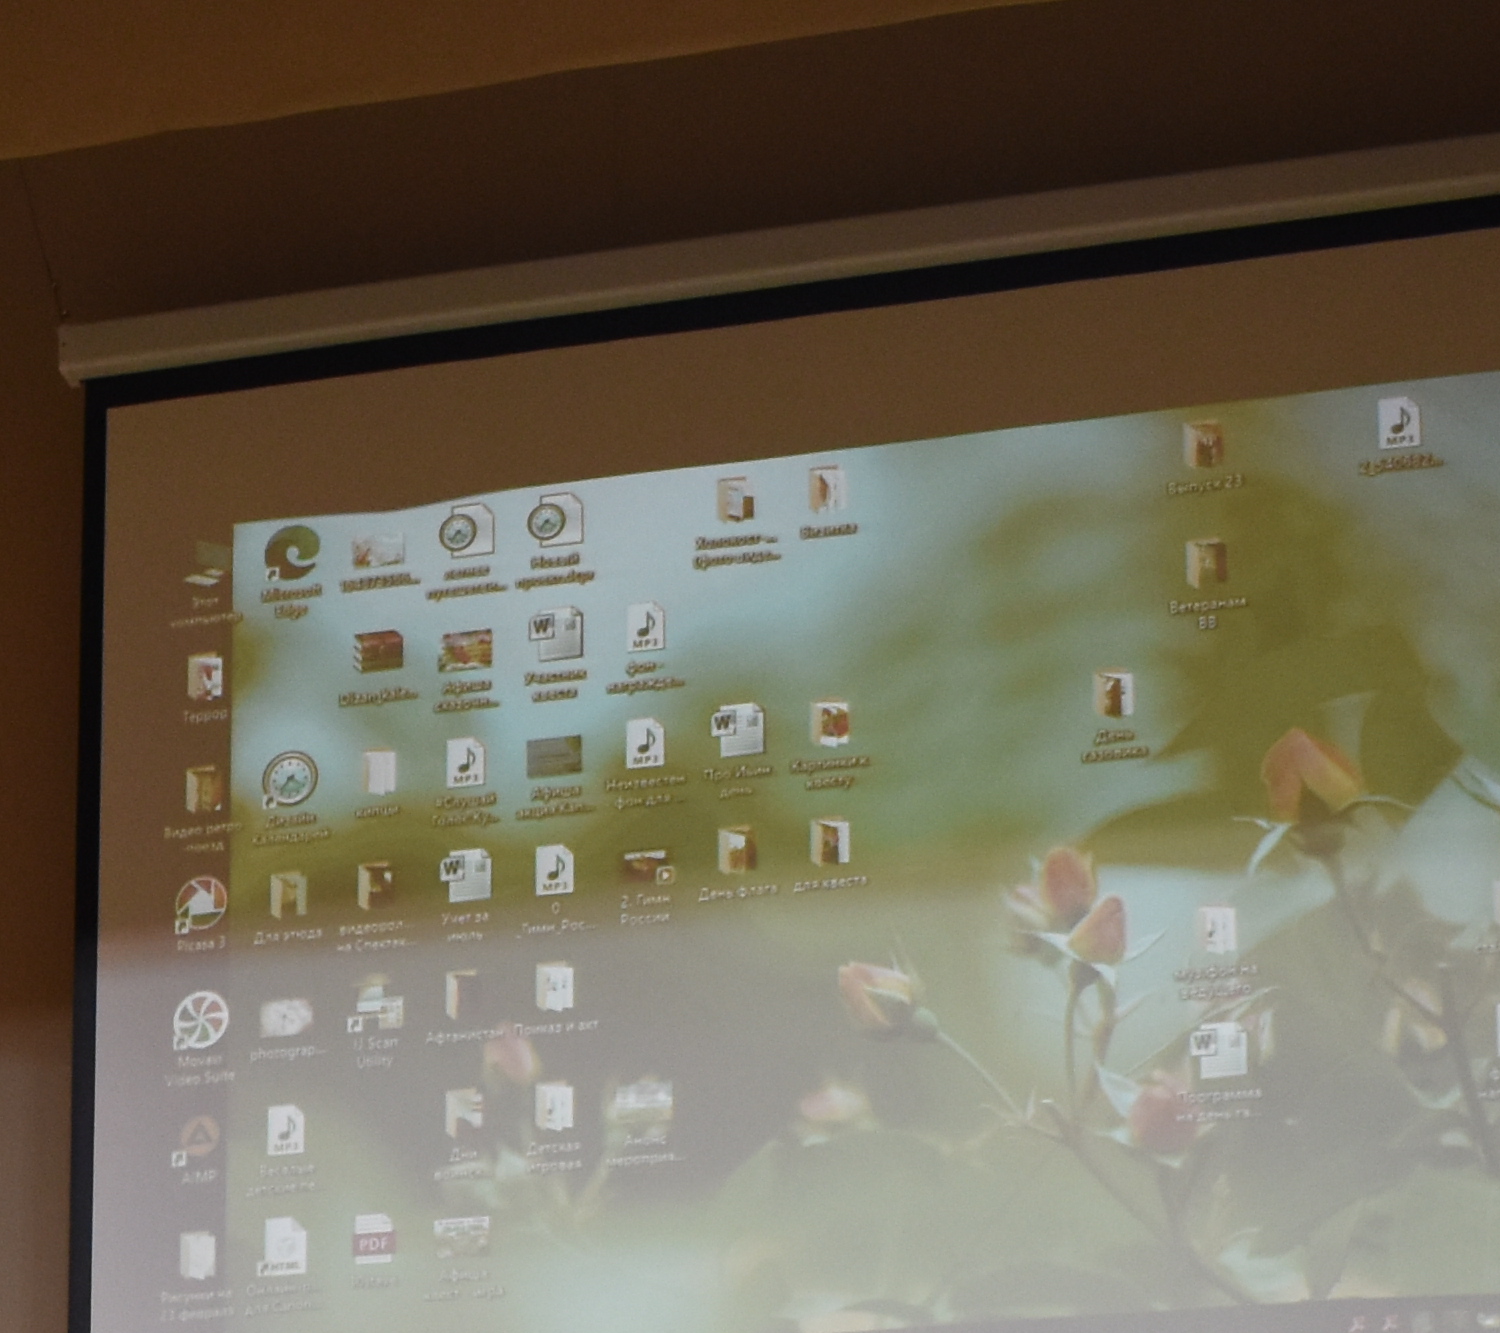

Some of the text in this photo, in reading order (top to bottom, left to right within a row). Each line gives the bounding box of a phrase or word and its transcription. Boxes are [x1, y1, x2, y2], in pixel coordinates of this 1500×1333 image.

[619, 911, 672, 926] России
[176, 936, 227, 952] Picasa 3
[367, 1037, 399, 1051] Scan
[356, 1054, 394, 1070] Utility
[359, 1236, 389, 1252] PDF
